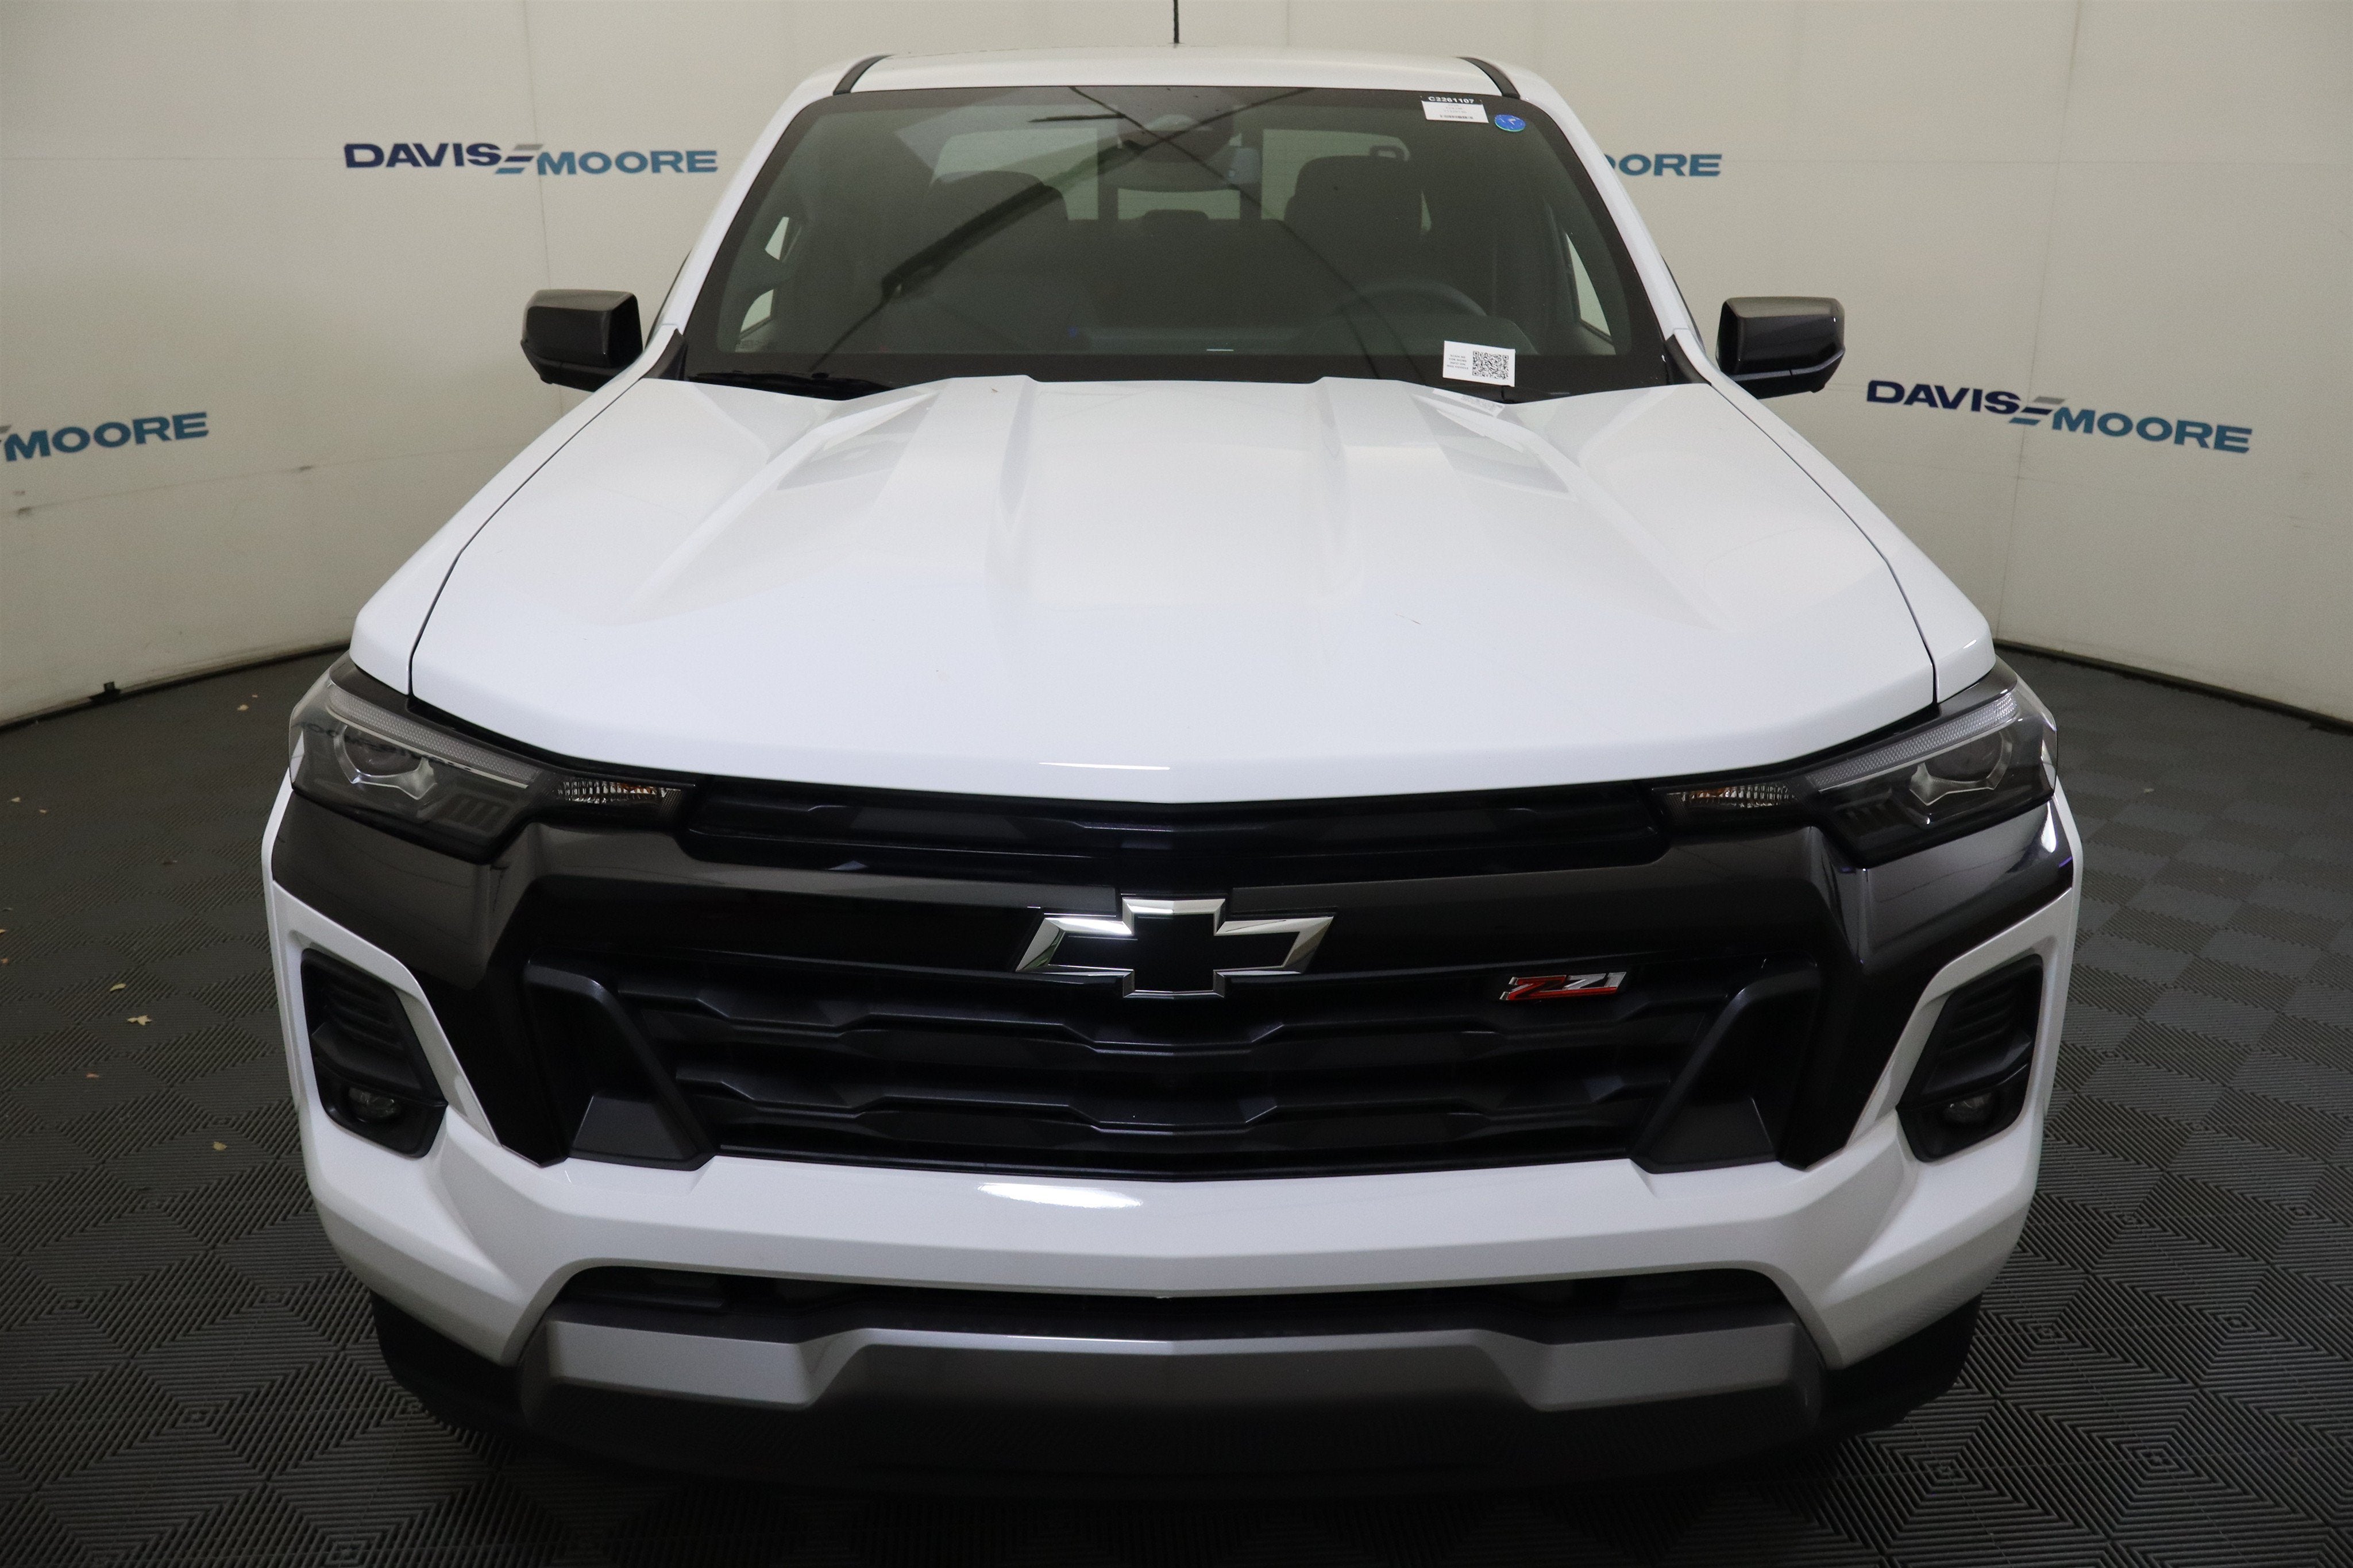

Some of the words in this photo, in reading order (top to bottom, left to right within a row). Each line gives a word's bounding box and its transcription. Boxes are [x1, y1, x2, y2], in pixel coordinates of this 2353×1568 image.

[344, 143, 502, 168] DAVIS
[537, 150, 718, 176] MOORE
[3, 412, 210, 462] MOORE
[1866, 380, 2021, 414] DAVIS
[2051, 407, 2253, 454] MOORE
[1499, 972, 1627, 1001] Z71
